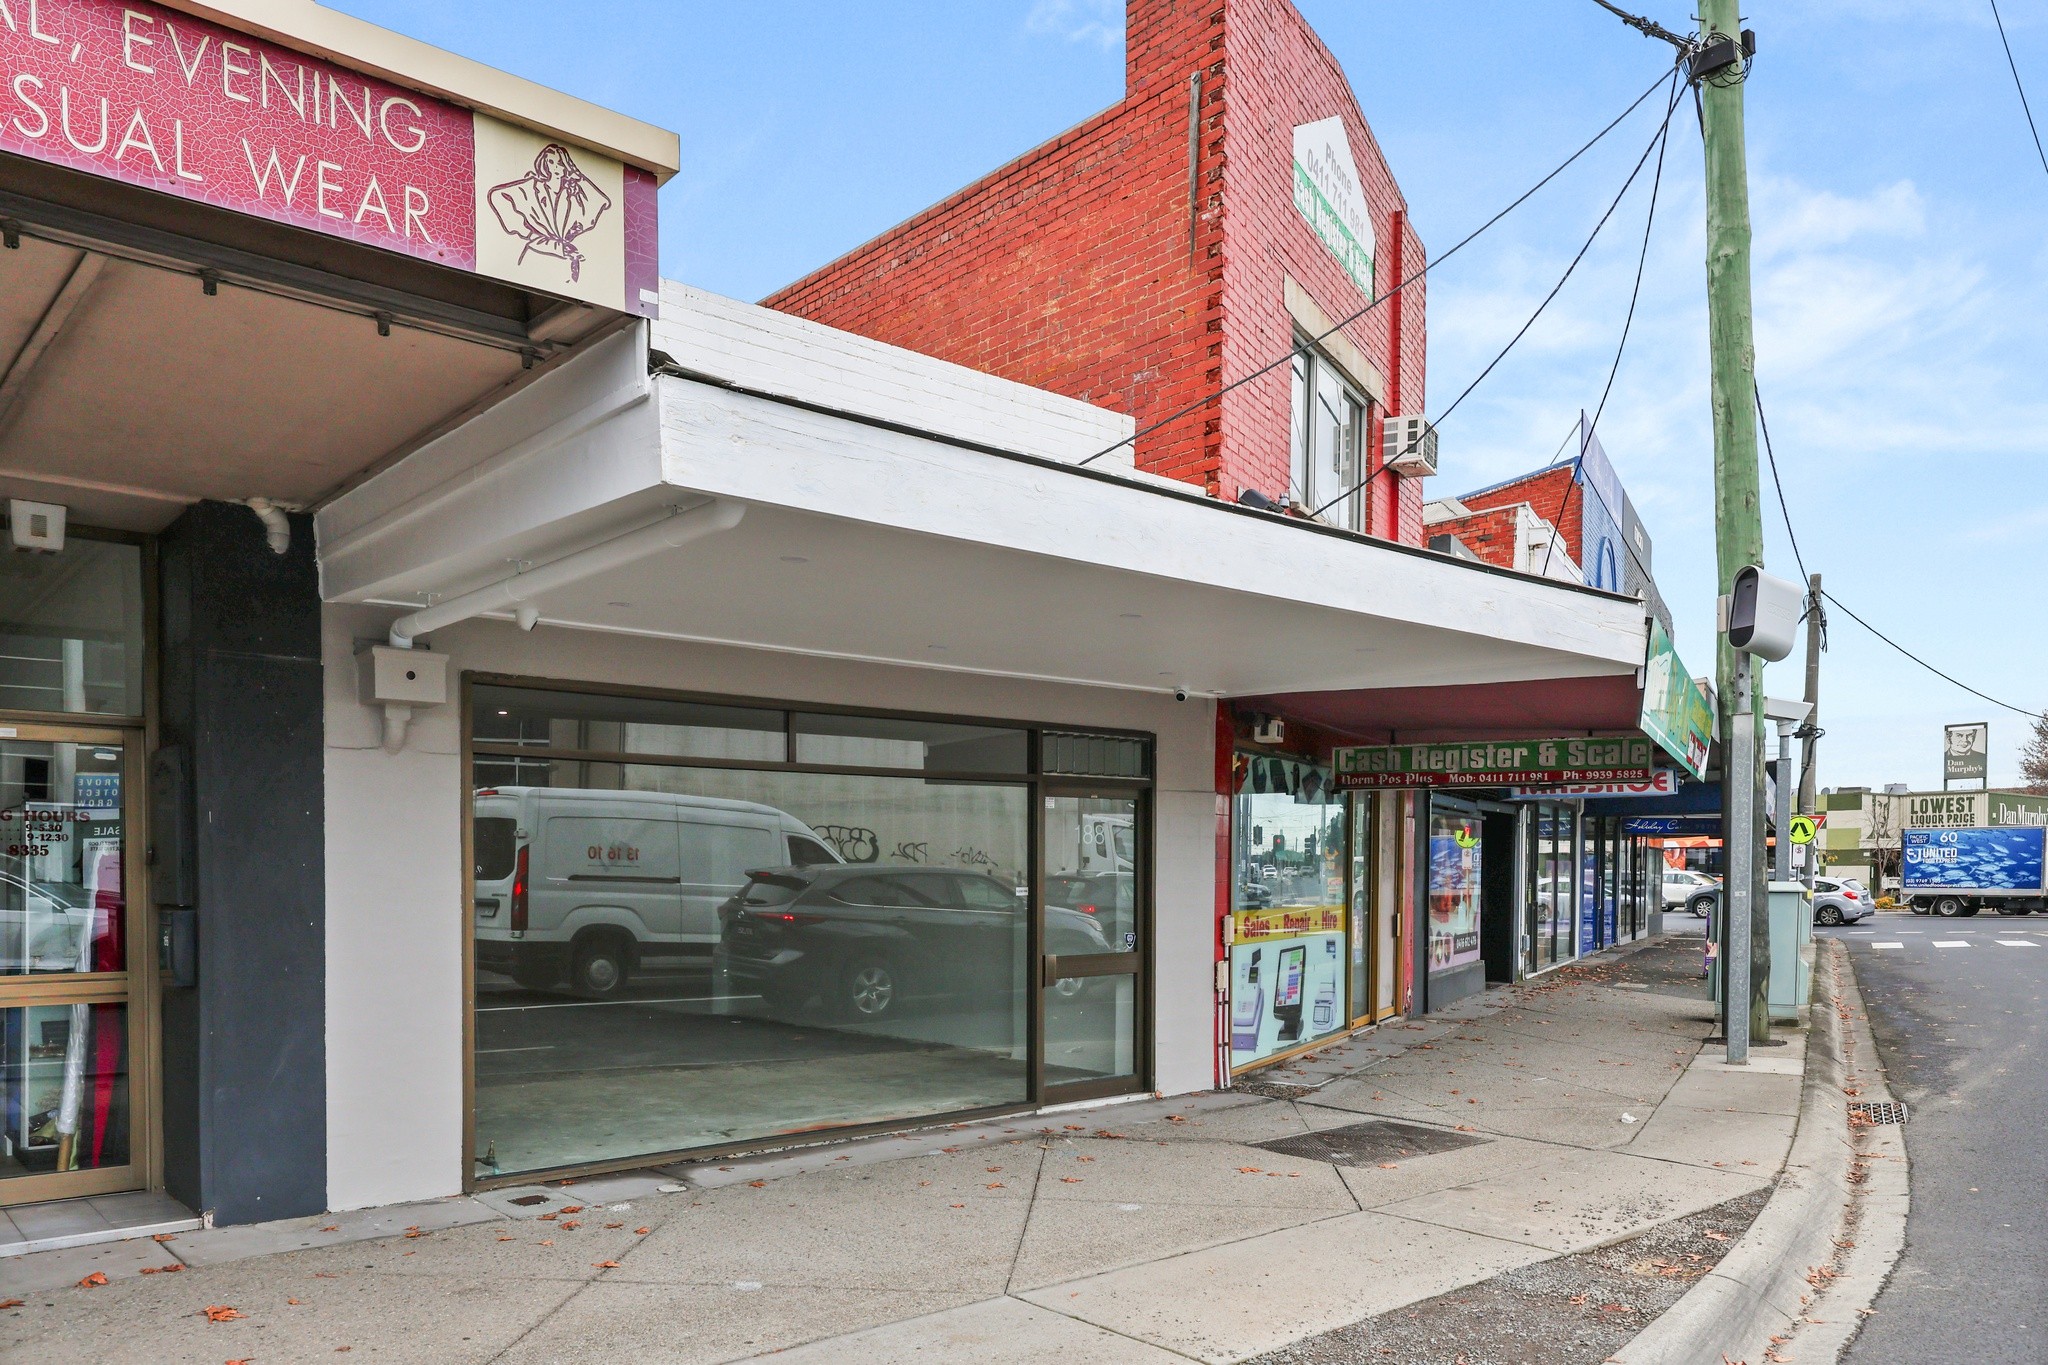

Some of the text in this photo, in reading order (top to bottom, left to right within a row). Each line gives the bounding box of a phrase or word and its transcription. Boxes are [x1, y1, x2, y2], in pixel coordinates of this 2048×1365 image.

[123, 9, 426, 153] EVENING
[0, 74, 434, 244] SUAL WEAR
[1325, 142, 1352, 196] Phone
[1307, 148, 1365, 242] 0411 711 981
[1338, 739, 1648, 773] Cash Register & Scale
[1378, 773, 1401, 785] Pos
[1405, 772, 1434, 785] Plus
[1448, 772, 1477, 783] Mob:
[1479, 772, 1503, 783] 0411
[1508, 772, 1526, 782] 711
[1530, 771, 1549, 781] 981
[1562, 769, 1583, 780] Ph:
[1586, 770, 1614, 780] 9939
[1616, 769, 1643, 779] 5825
[1946, 764, 1983, 774] Murphy's
[1910, 797, 1975, 815] LOWEST
[1999, 802, 2017, 825] Dan
[23, 810, 91, 823] HOURS
[1910, 813, 1975, 825] LIQUOR PRICE
[1074, 824, 1105, 844] 188
[1940, 831, 1958, 843] 60
[8, 844, 49, 857] 8335
[1923, 847, 1958, 858] UNITED
[1243, 910, 1338, 938] Sales Repair Hire
